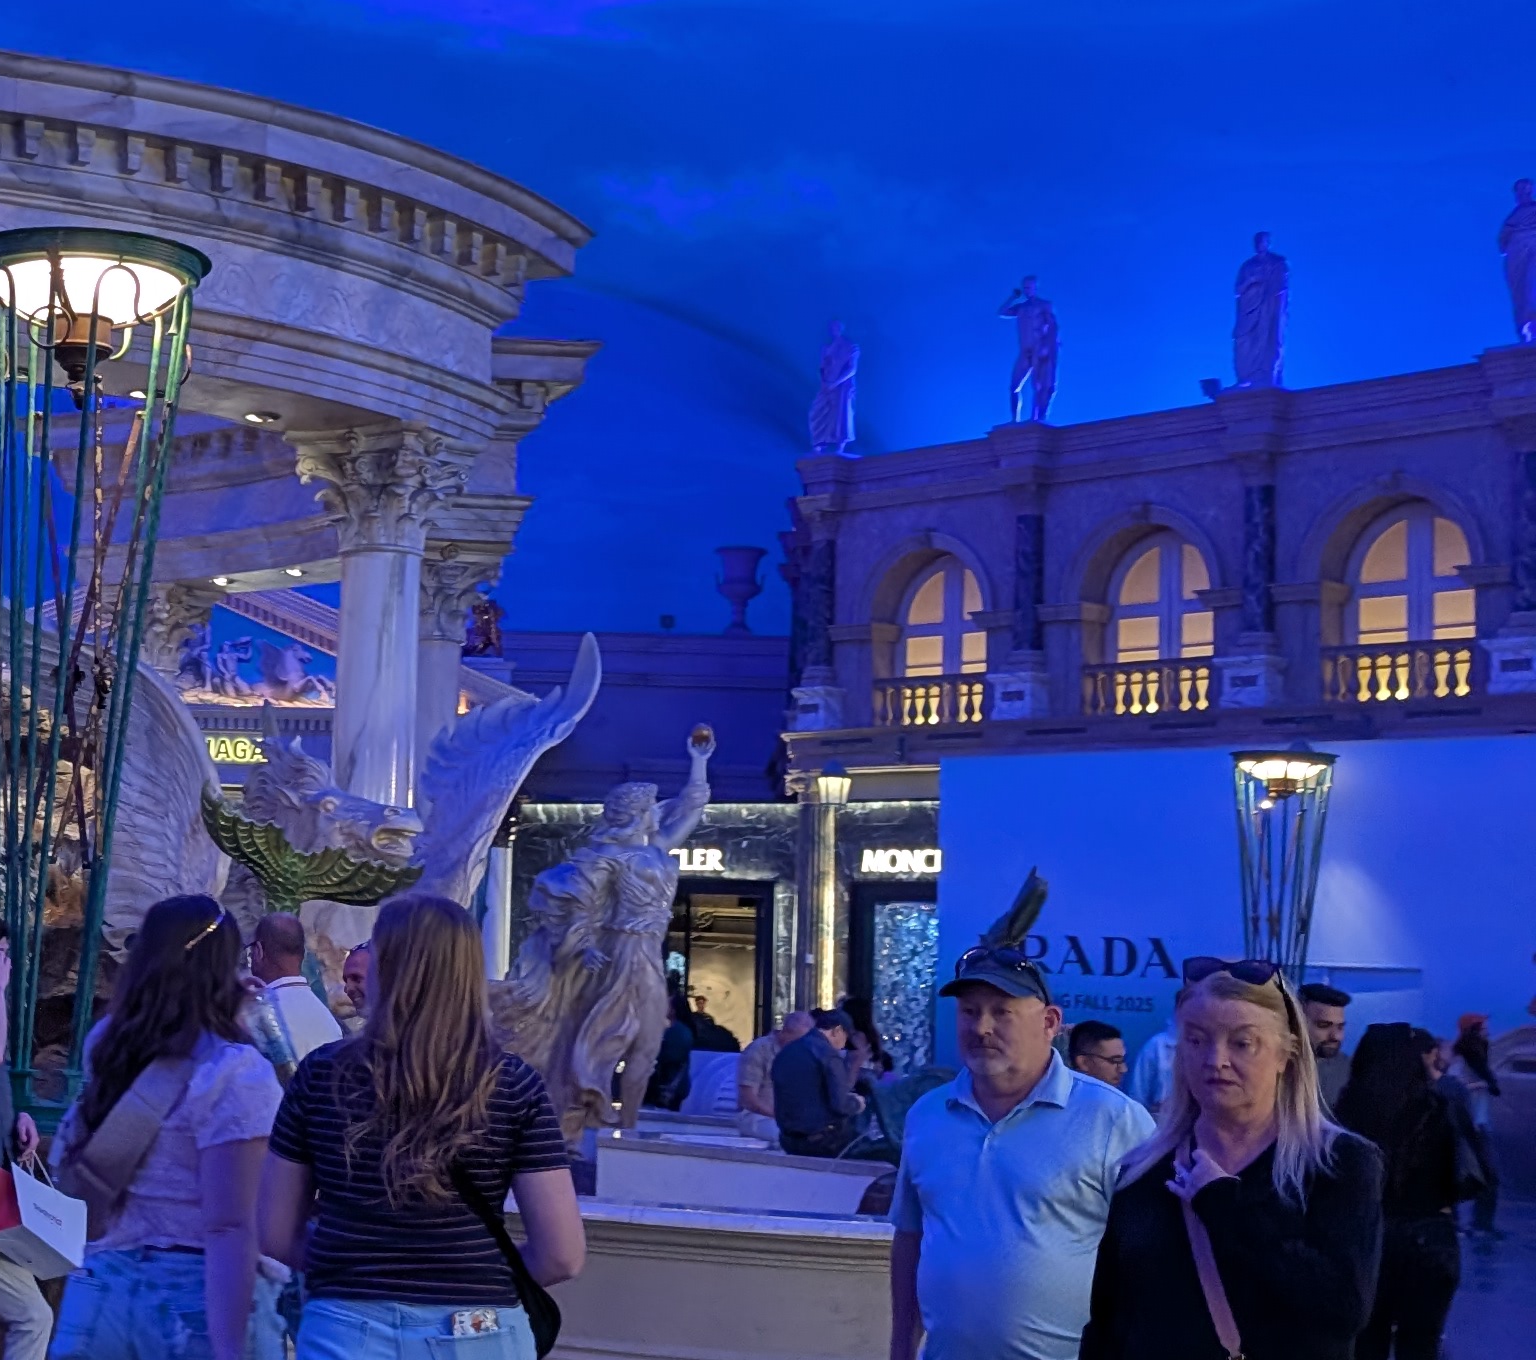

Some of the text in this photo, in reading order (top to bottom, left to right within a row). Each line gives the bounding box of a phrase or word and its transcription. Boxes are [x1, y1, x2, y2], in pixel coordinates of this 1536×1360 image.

[668, 848, 726, 871] LER
[978, 934, 1181, 979] RADA
[1074, 994, 1113, 1011] FALL
[1115, 995, 1153, 1013] 2025
